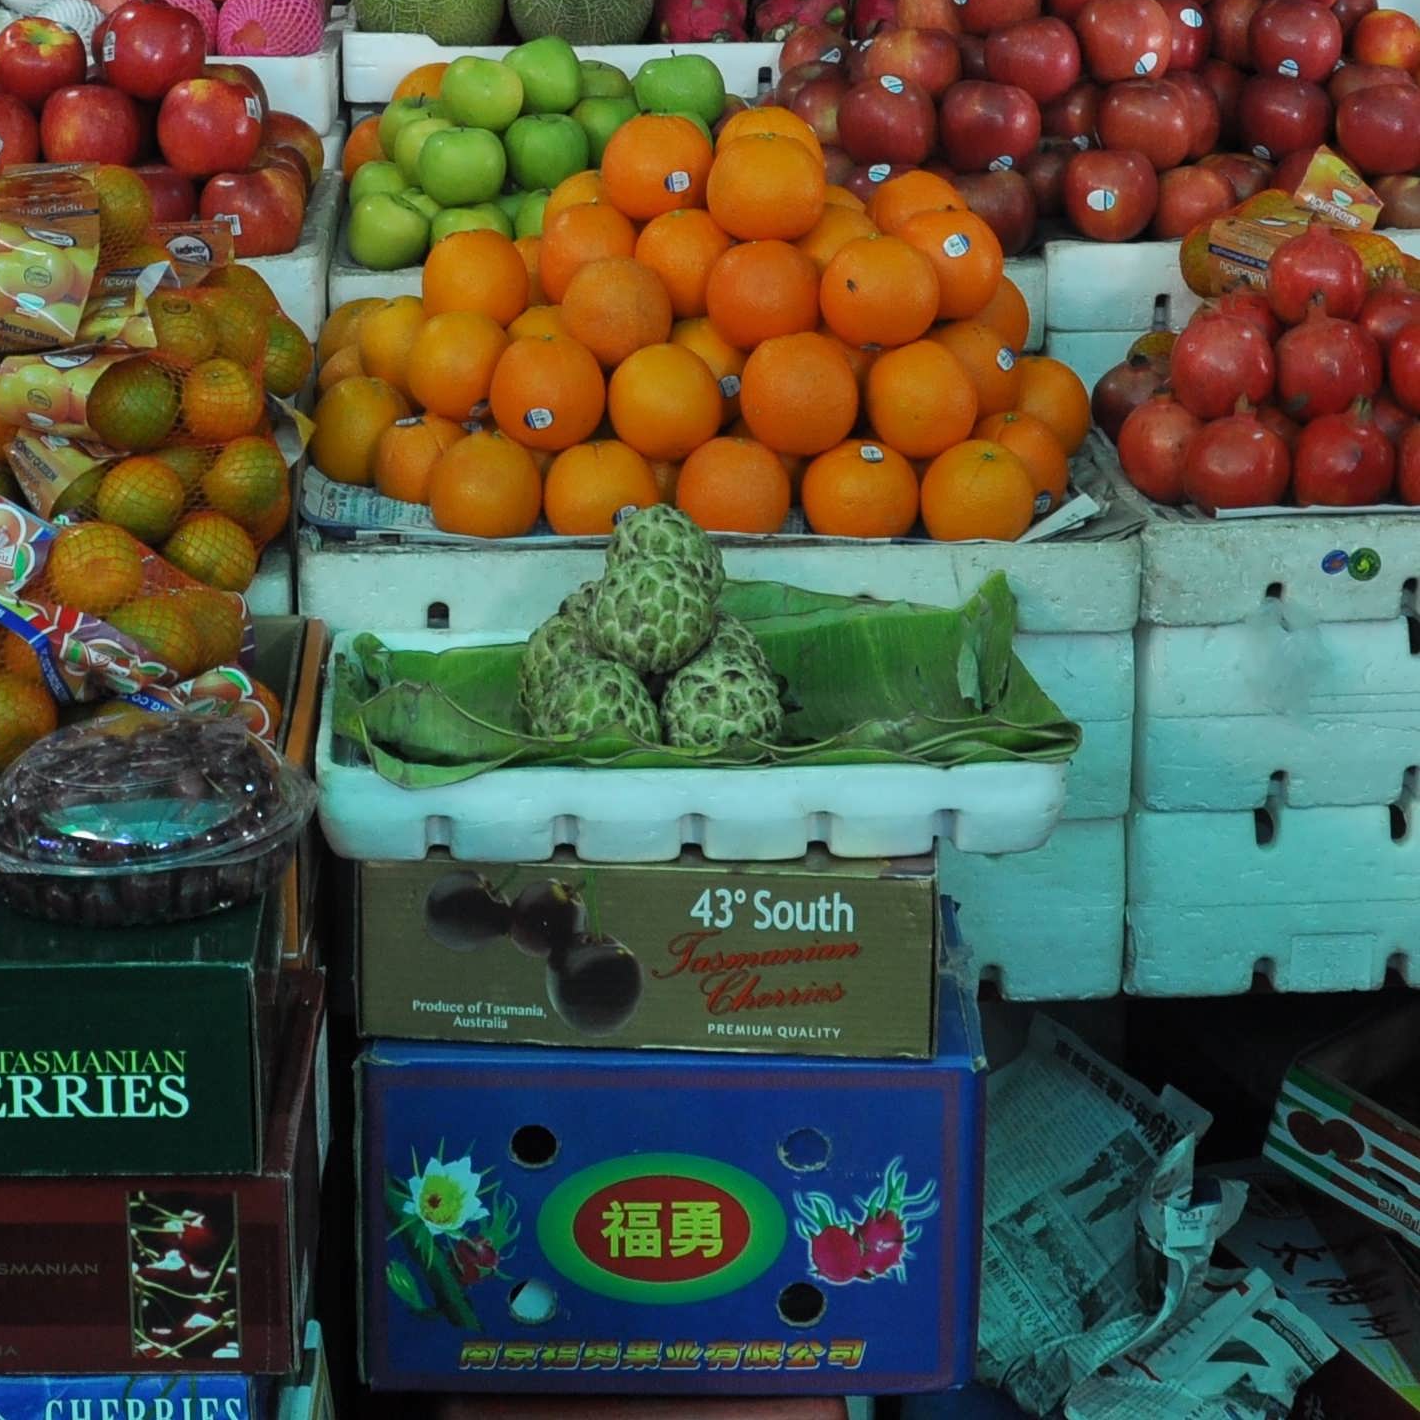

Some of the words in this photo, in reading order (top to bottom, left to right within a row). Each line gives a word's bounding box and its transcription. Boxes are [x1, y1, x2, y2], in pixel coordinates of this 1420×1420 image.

[690, 888, 747, 928] 43°
[753, 890, 854, 932] South
[651, 930, 862, 979] Tasmanian
[412, 999, 464, 1014] Produce
[467, 1001, 482, 1014] of
[484, 1003, 547, 1019] Tasmania,
[699, 969, 847, 1016] Cherries
[453, 1015, 508, 1029] Australia
[707, 1023, 773, 1037] PREMIUM
[777, 1026, 842, 1040] QUALITY
[601, 1201, 725, 1260] 福勇
